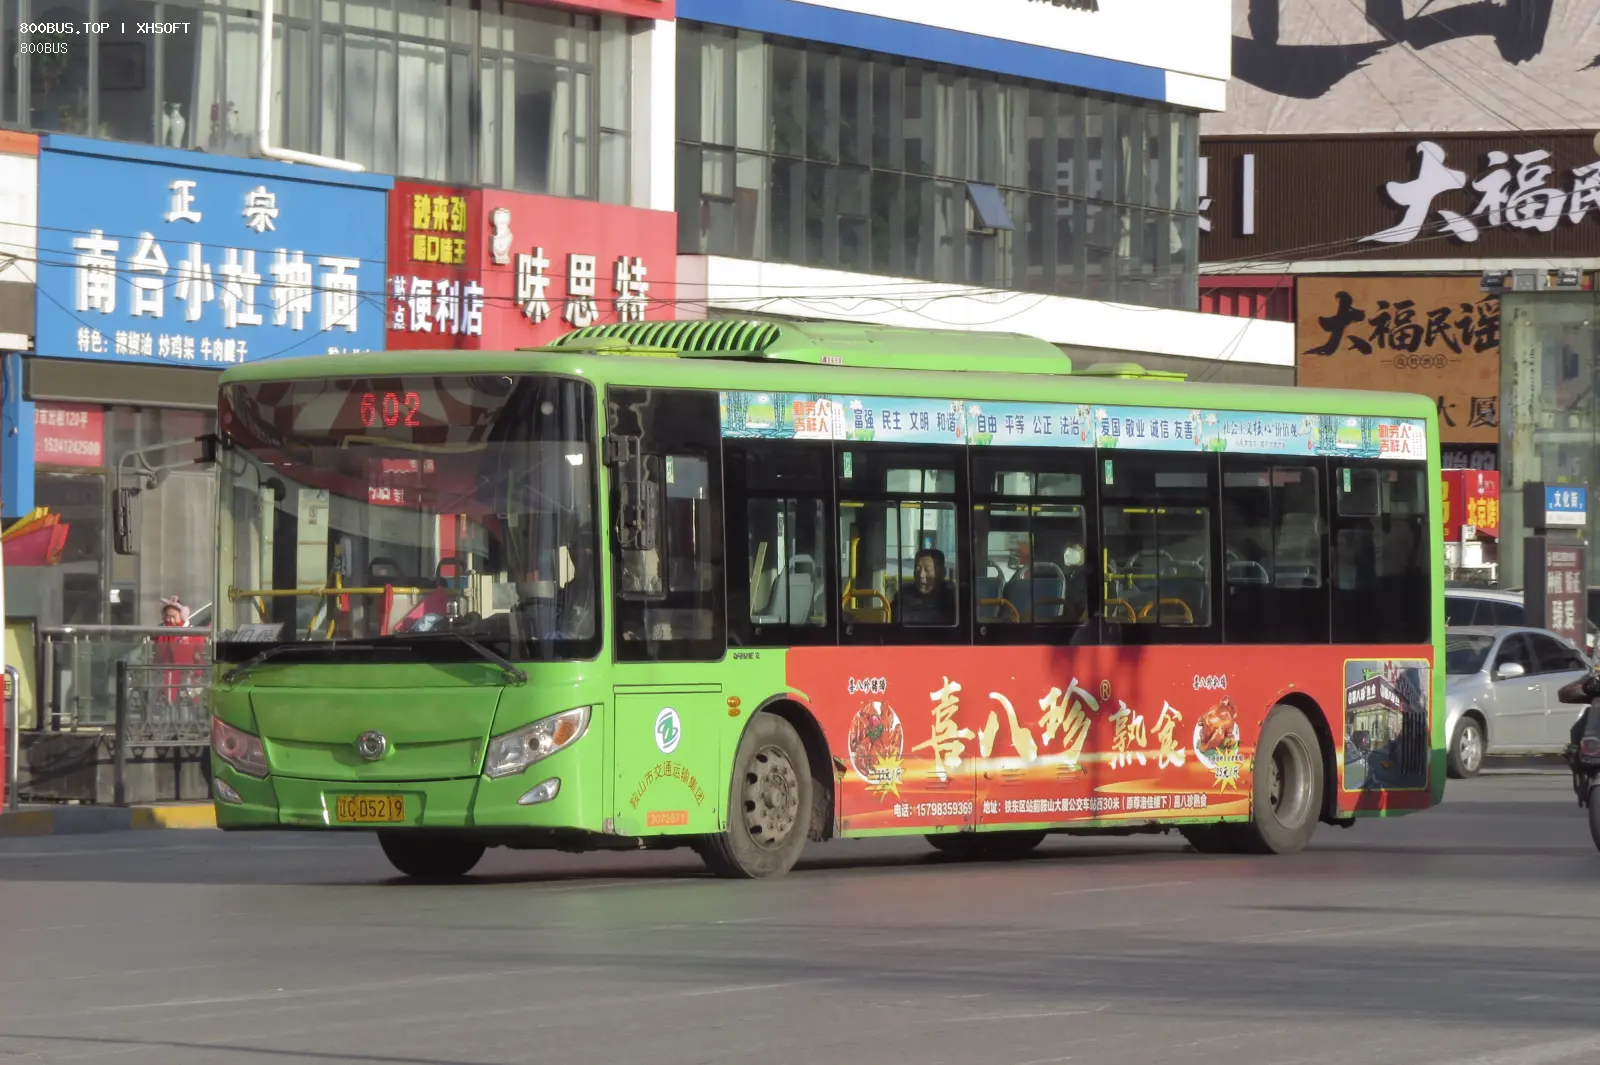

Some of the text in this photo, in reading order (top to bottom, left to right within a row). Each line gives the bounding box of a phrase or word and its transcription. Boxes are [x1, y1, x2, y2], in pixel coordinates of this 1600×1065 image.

[164, 180, 279, 233] 正宗
[408, 275, 485, 336] 便利店
[514, 246, 650, 328] 味思特
[359, 391, 421, 428] 602
[853, 408, 875, 430] 富强
[881, 409, 902, 431] 民主
[909, 410, 930, 432] 文明
[936, 411, 956, 433] 和谐
[977, 414, 1080, 437] 自由 平等 公正 法治
[1100, 417, 1194, 441] 爱国 敬业 诚信 友善
[911, 676, 1101, 783] 喜八珍
[1108, 699, 1187, 771] 熟食
